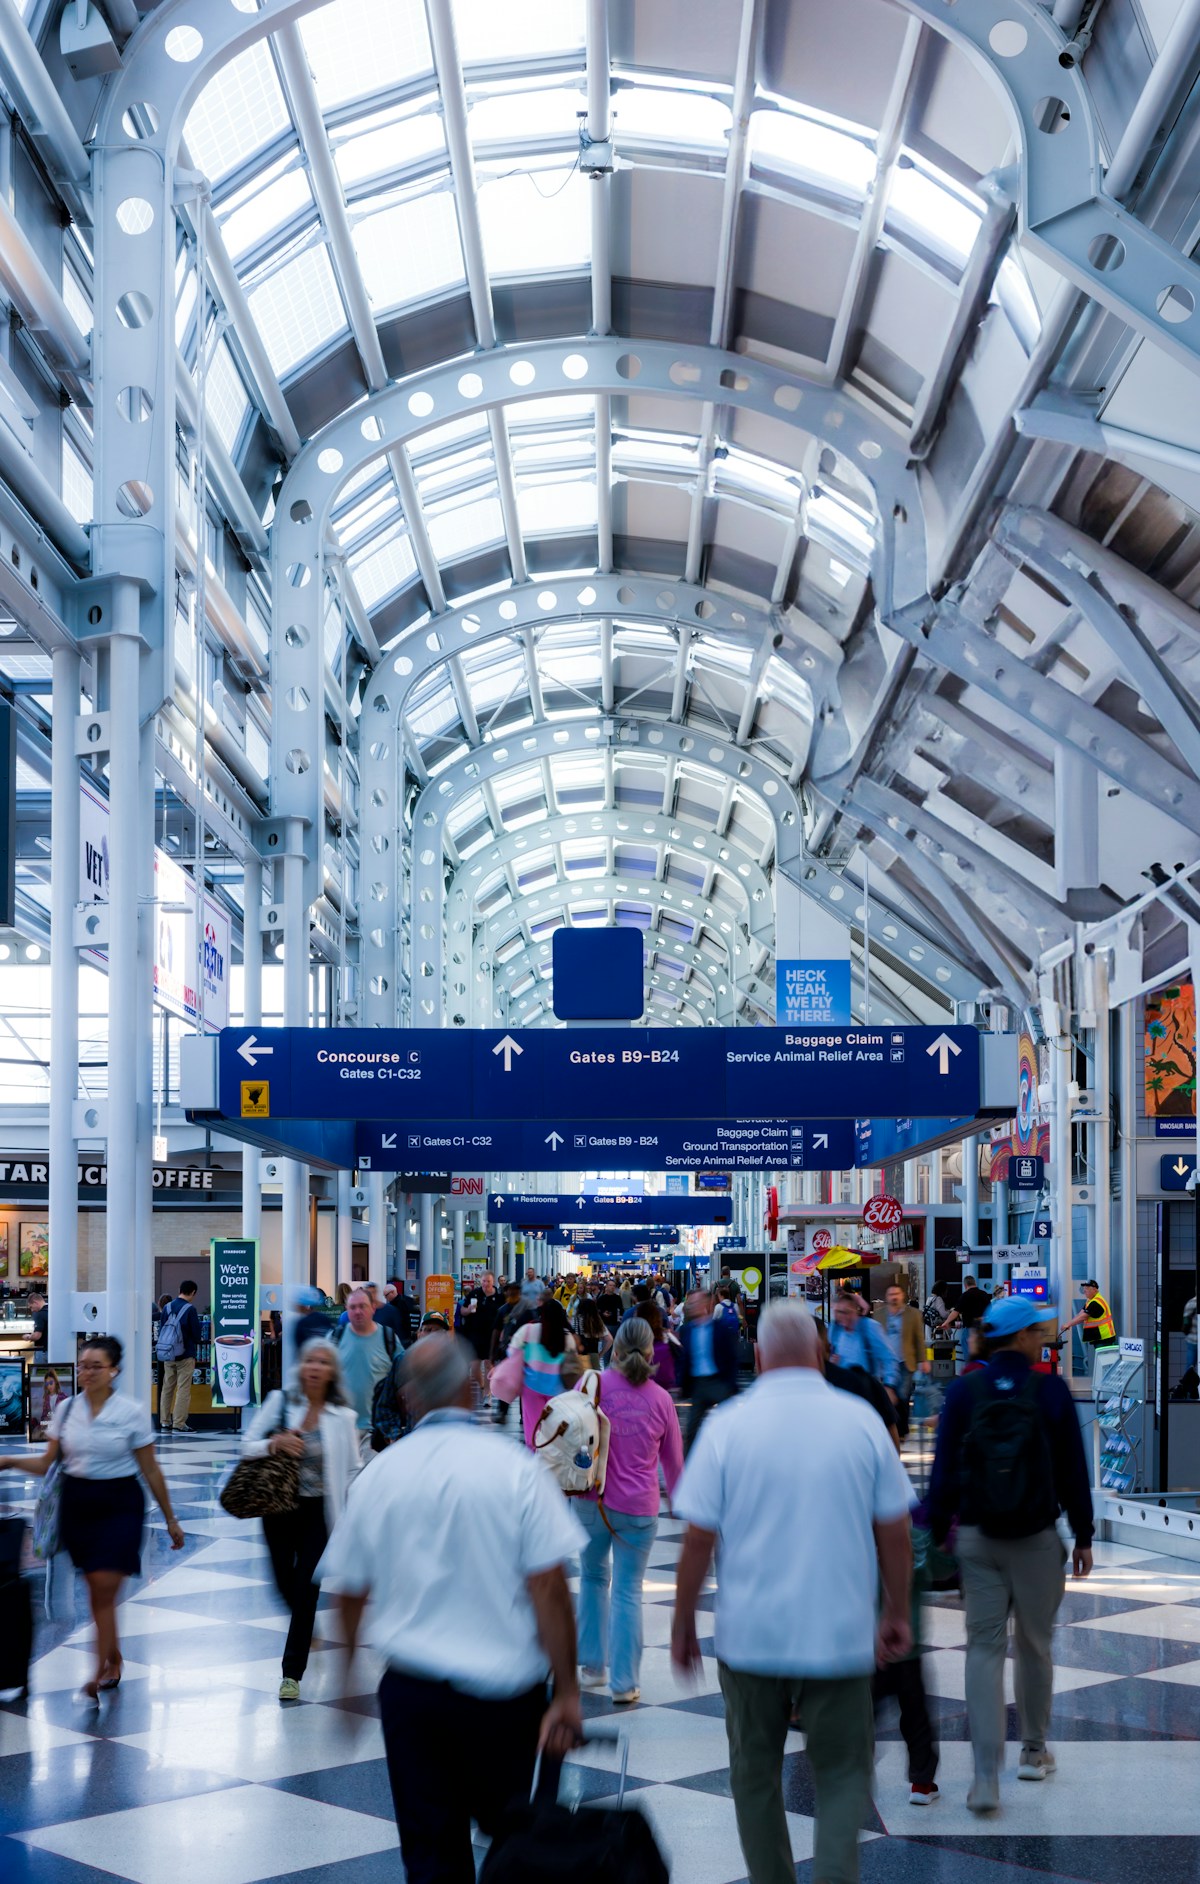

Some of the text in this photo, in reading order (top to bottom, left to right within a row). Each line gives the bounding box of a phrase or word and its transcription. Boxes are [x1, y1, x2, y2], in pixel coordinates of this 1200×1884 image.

[85, 841, 103, 888] VET
[785, 969, 827, 983] HECK
[785, 983, 830, 997] YEAH,
[785, 995, 834, 1009] WE FLY
[785, 1009, 835, 1022] THERE.
[785, 1034, 884, 1048] Baggage Claim
[316, 1049, 419, 1064] Concourse C
[570, 1050, 680, 1064] Gates B9-B24
[726, 1051, 884, 1063] Service Animal Relief Area
[339, 1067, 422, 1079] Gates C1-C32
[716, 1127, 789, 1140] Baggage Claim
[422, 1136, 452, 1146] Gates
[588, 1136, 618, 1146] Gates
[682, 1141, 789, 1153] Ground Transportation
[665, 1155, 789, 1166] Service Animal Relief Area
[152, 1169, 213, 1189] OFFEE
[451, 1178, 483, 1195] CNN
[593, 1196, 615, 1204] Gates
[864, 1201, 902, 1224] Eli's
[220, 1264, 249, 1274] We're
[1023, 1269, 1042, 1278] ATM
[220, 1275, 248, 1287] Open
[1124, 1342, 1142, 1352] CHICAGO
